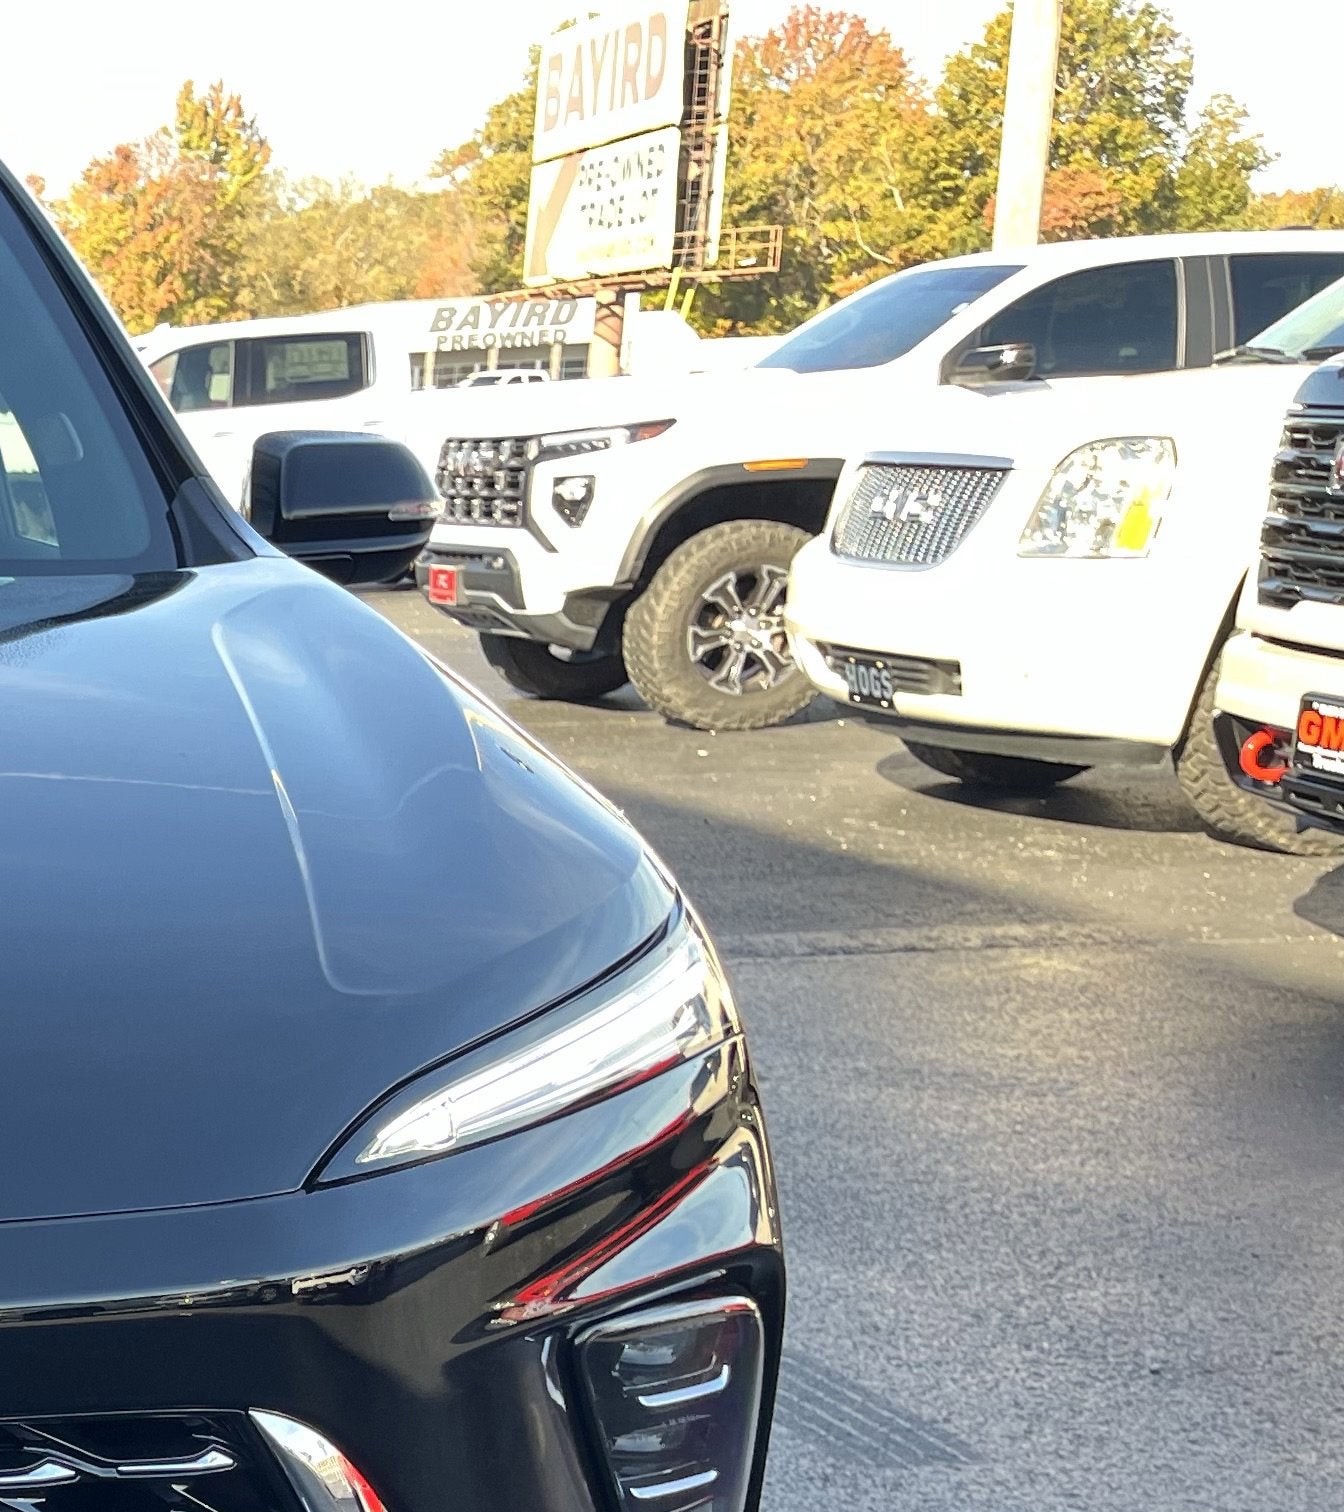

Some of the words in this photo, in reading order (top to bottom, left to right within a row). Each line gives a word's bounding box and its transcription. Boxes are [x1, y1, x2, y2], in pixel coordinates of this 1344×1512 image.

[543, 12, 667, 132] BAYIRD
[429, 300, 578, 332] BAYIRD
[436, 329, 567, 351] PREOWNED
[845, 663, 893, 700] HOGS
